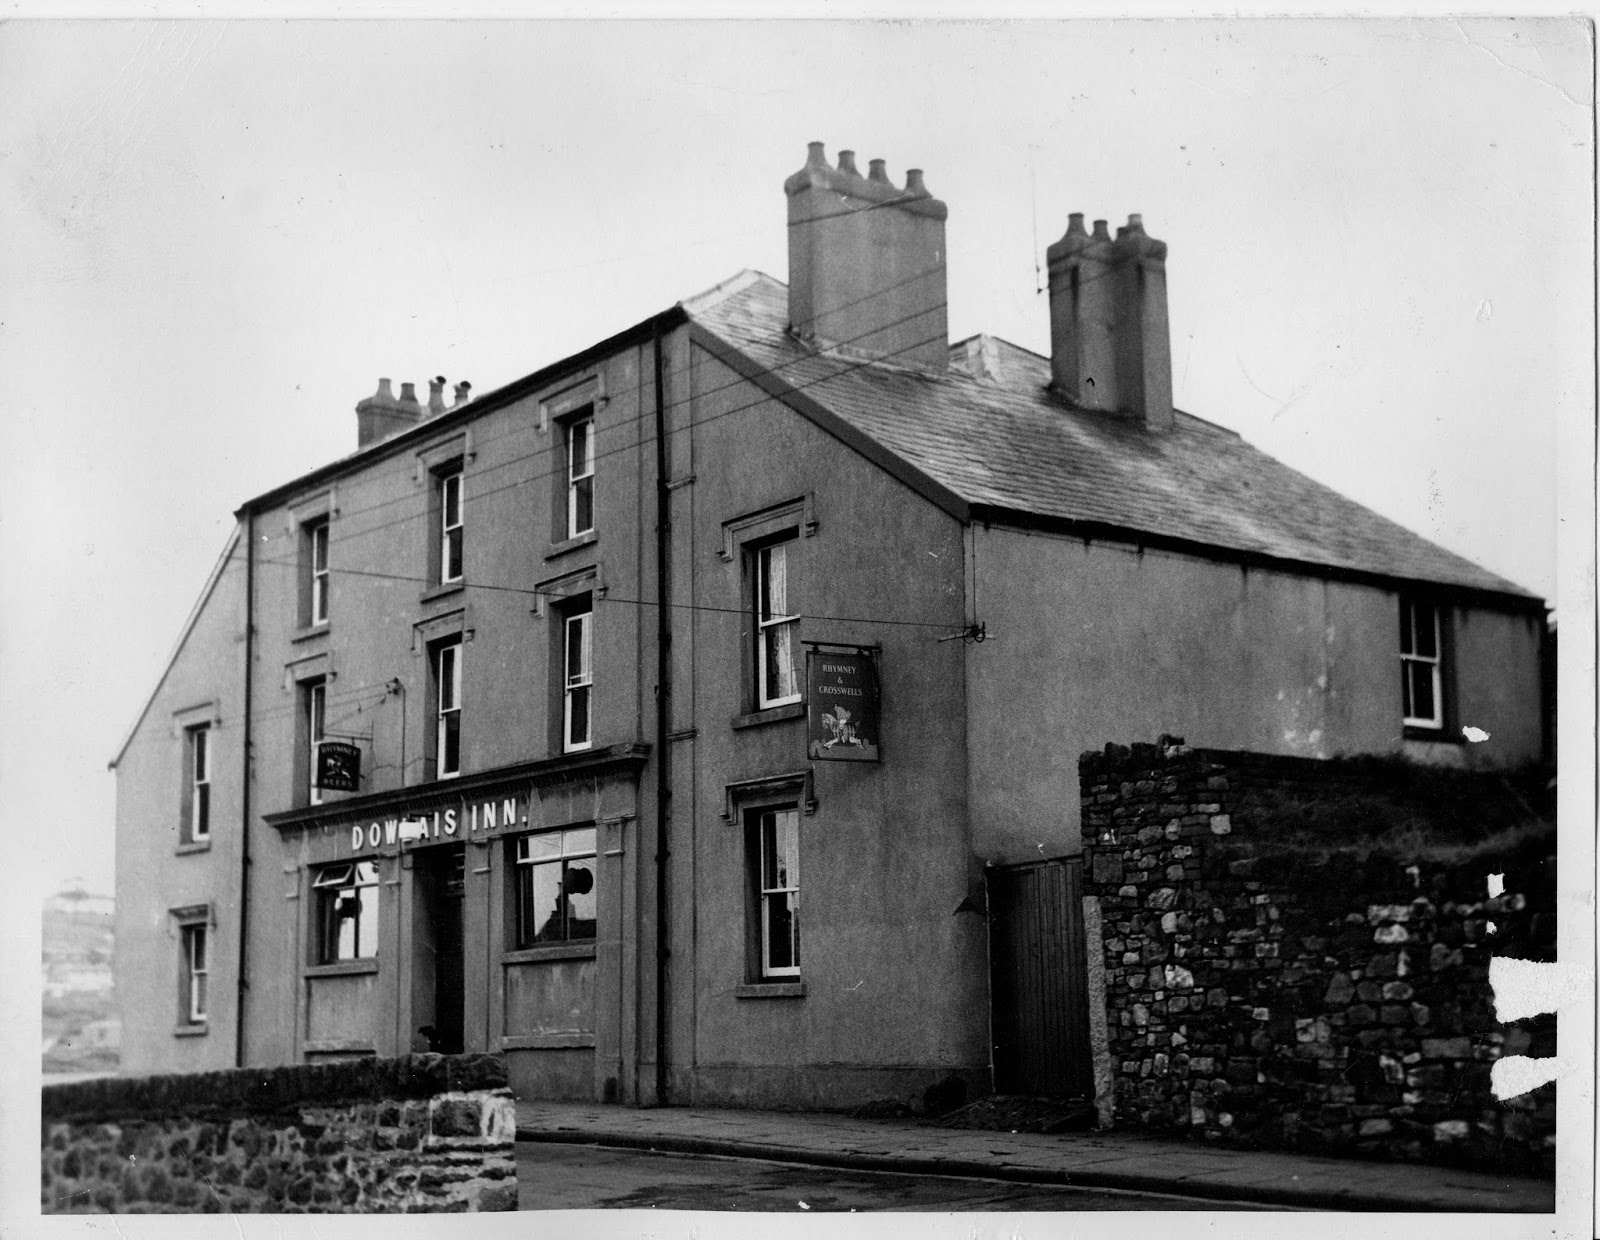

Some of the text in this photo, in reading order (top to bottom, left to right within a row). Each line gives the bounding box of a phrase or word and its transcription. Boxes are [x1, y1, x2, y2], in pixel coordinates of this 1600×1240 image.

[822, 664, 857, 675] RHYMNEY
[837, 676, 843, 684] &
[818, 685, 863, 697] CROSSWELLS
[471, 798, 527, 831] INN.
